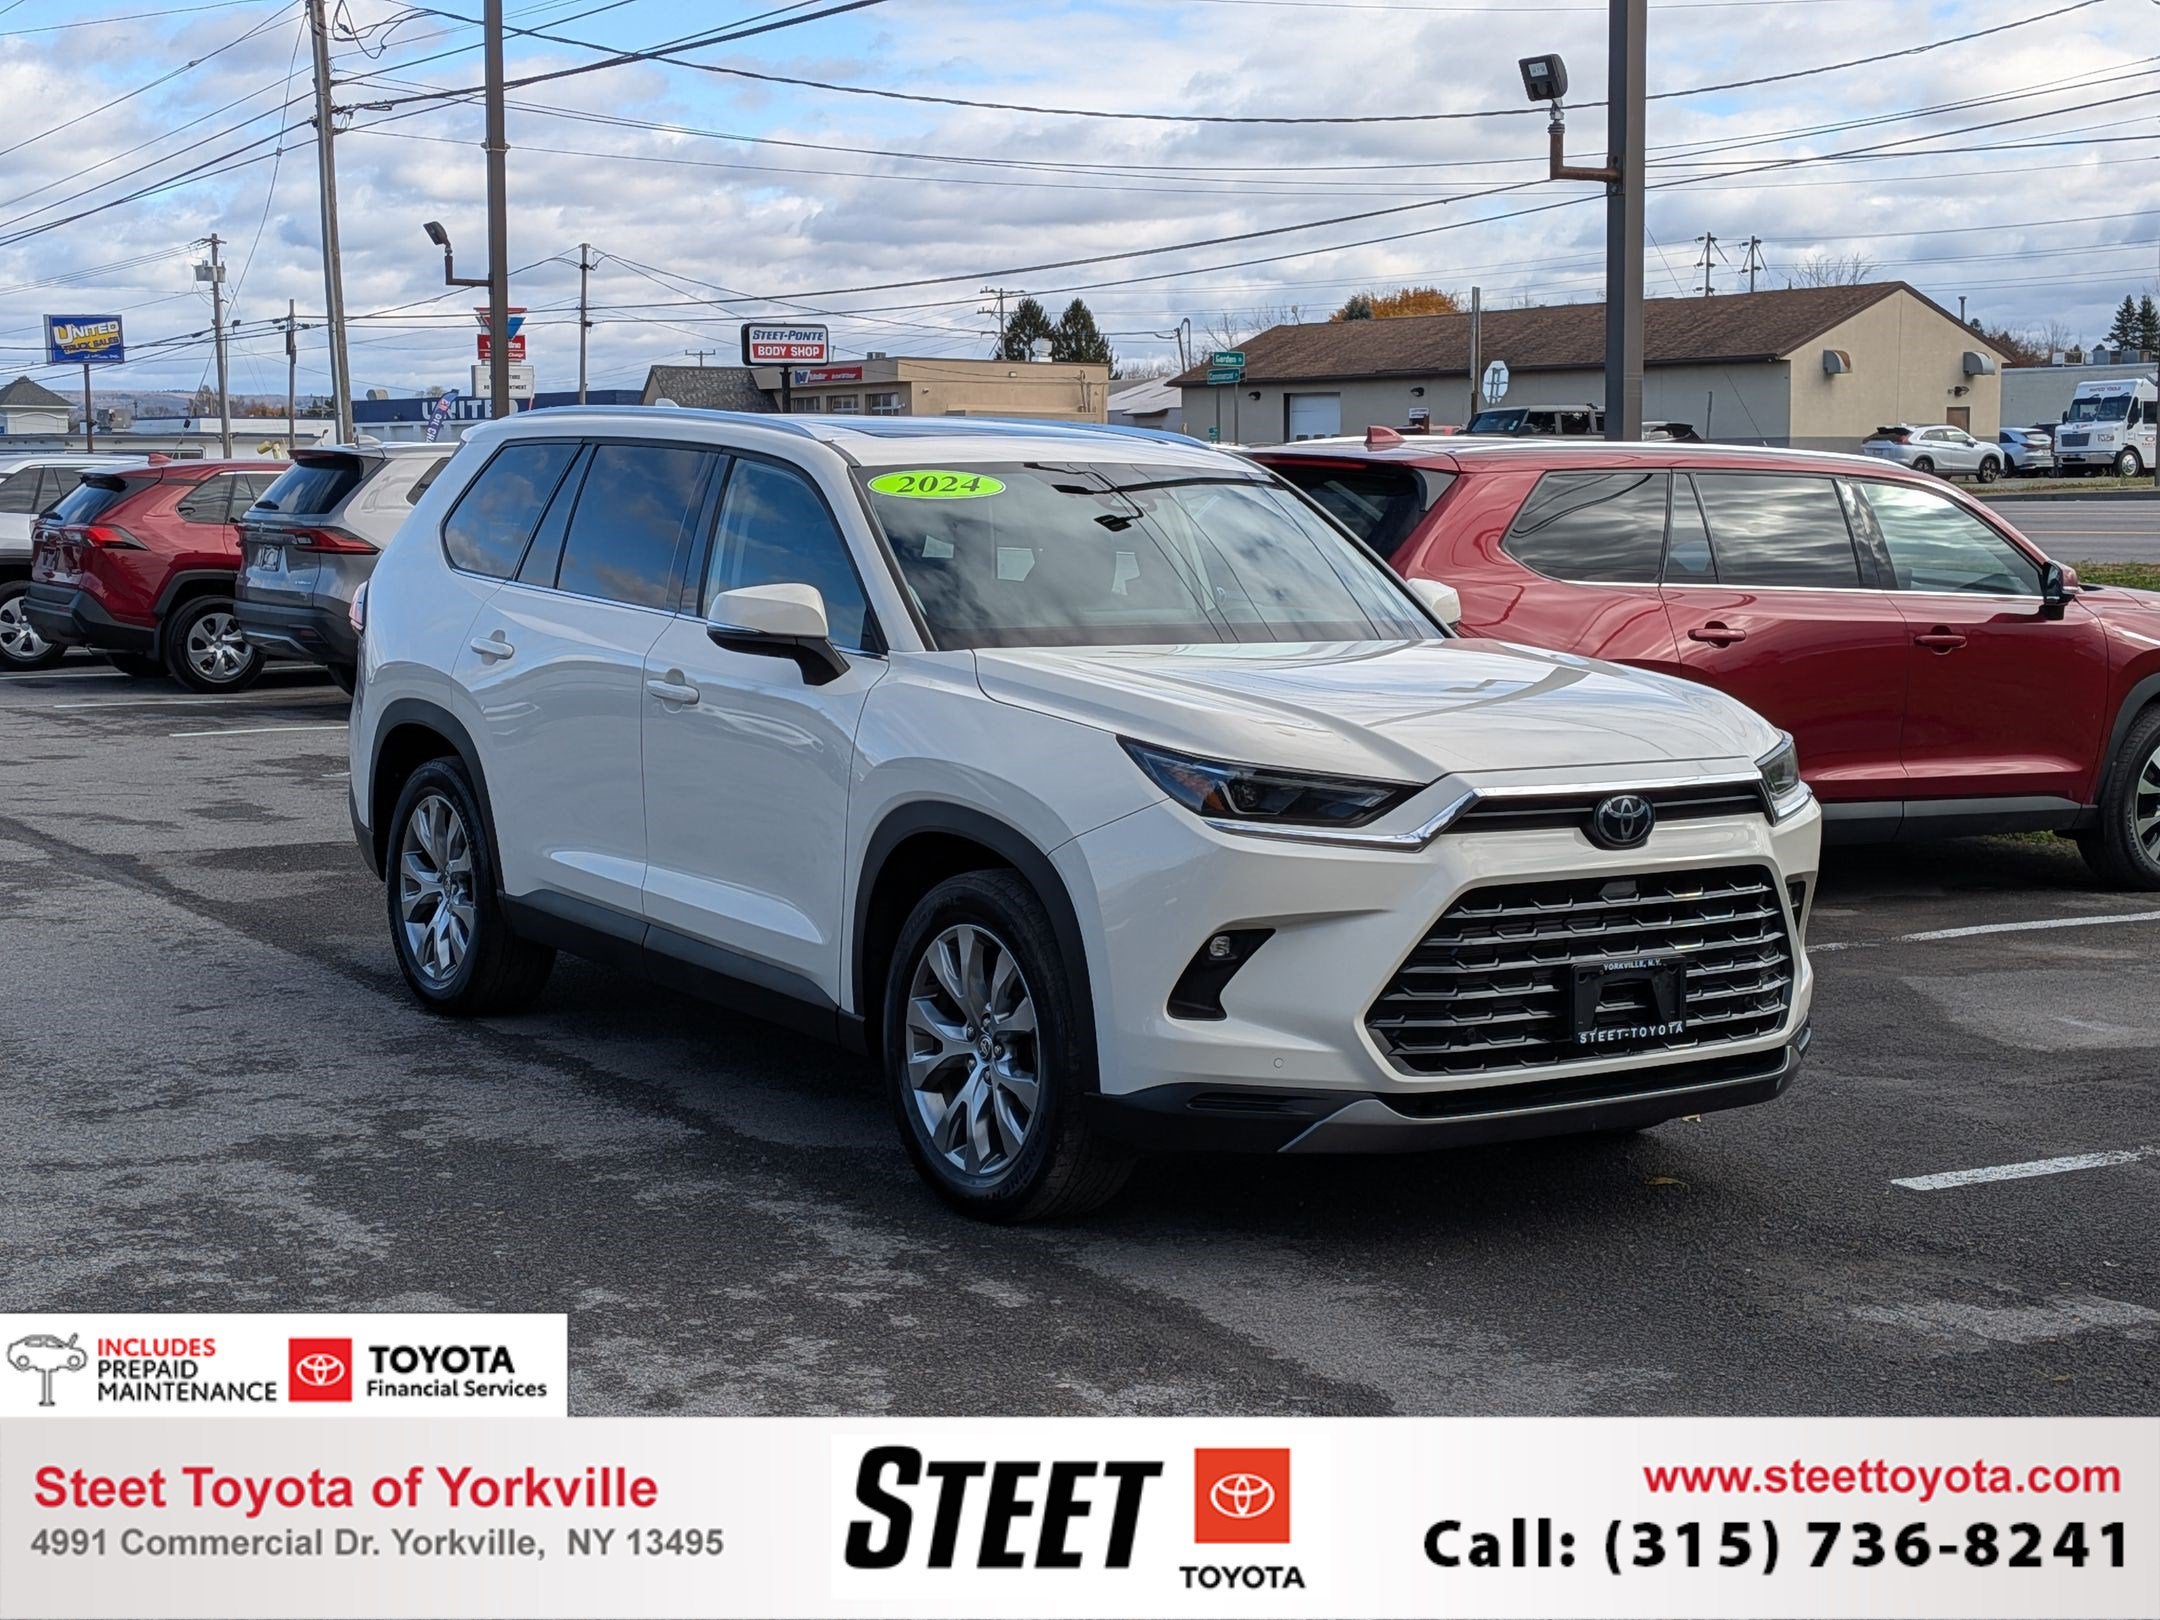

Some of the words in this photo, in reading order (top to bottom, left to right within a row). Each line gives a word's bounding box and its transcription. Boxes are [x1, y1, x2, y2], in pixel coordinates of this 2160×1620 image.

[54, 321, 119, 345] UNITED
[752, 330, 824, 341] STEET-PONTE
[94, 336, 119, 347] SALES
[758, 346, 787, 356] BODY
[790, 346, 819, 357] SHOP
[896, 475, 981, 493] 2024
